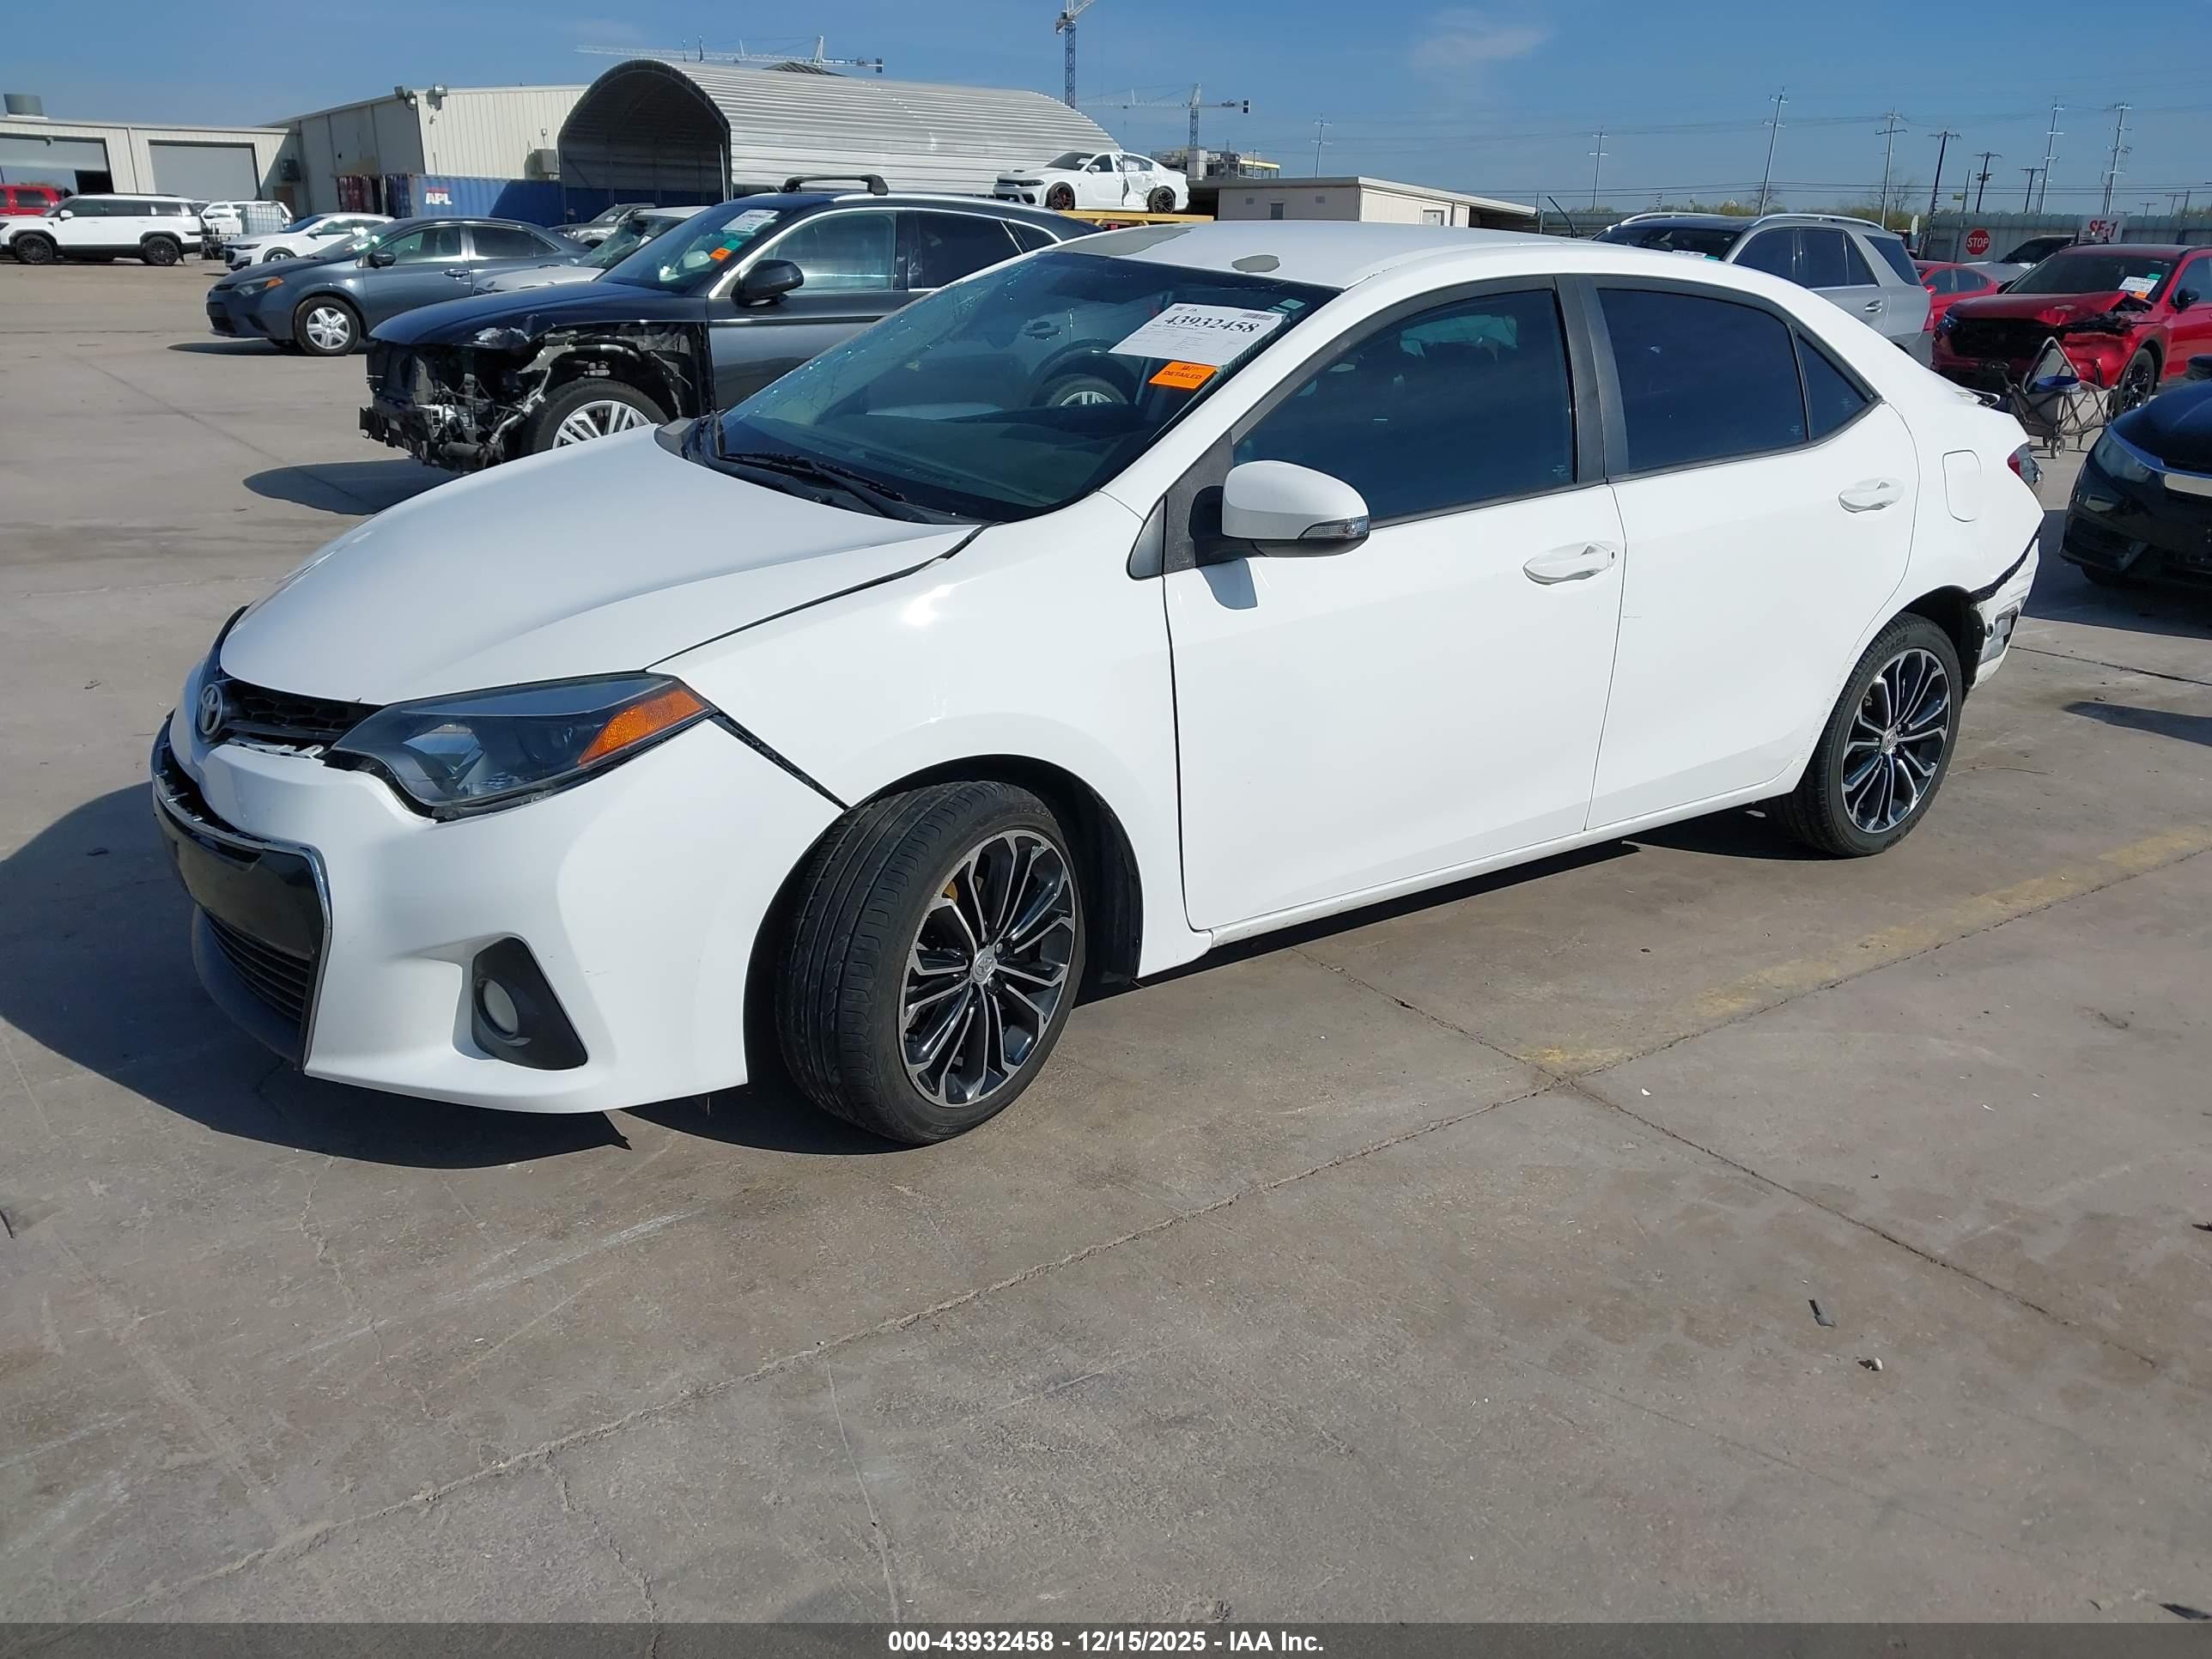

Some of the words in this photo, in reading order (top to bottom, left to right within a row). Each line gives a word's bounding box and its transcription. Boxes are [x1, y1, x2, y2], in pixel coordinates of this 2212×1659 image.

[426, 192, 453, 204] APL
[1967, 237, 1990, 248] STOP
[1164, 314, 1260, 333] 43932458
